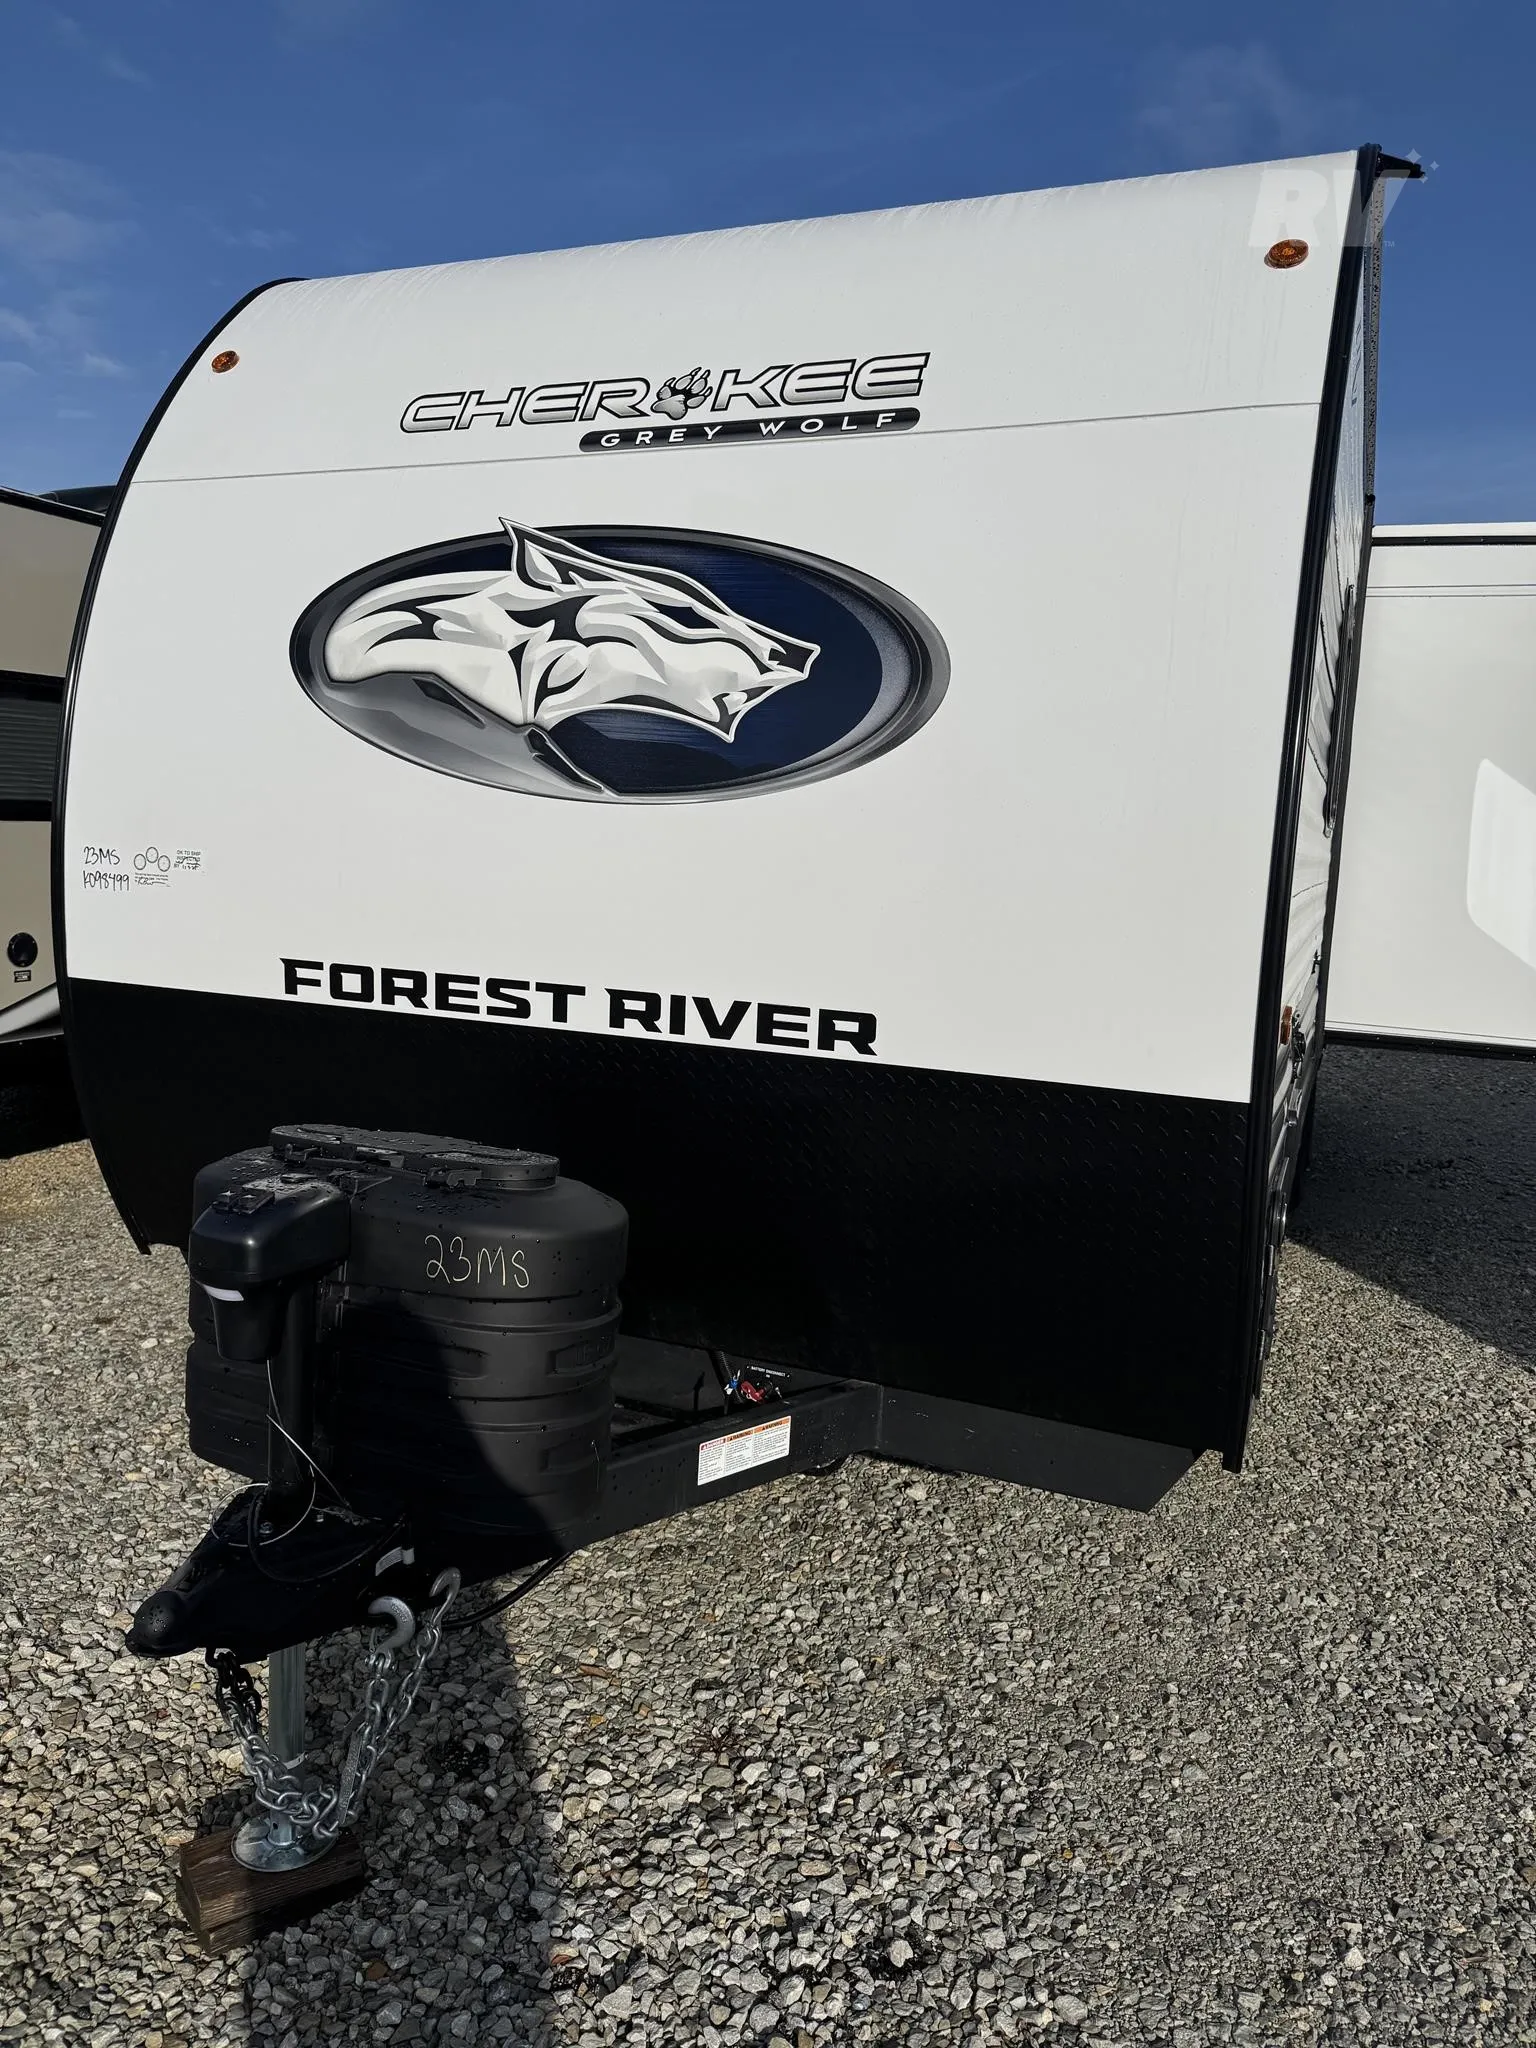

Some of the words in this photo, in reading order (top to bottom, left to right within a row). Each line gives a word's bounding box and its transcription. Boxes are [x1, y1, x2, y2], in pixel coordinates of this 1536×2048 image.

[400, 352, 931, 433] CHERKEE
[600, 425, 722, 448] GREY
[760, 411, 901, 435] WOLF
[83, 846, 121, 865] 23MS
[279, 957, 586, 1023] FOREST
[604, 987, 877, 1056] RIVER
[425, 1234, 530, 1288] 23MS
